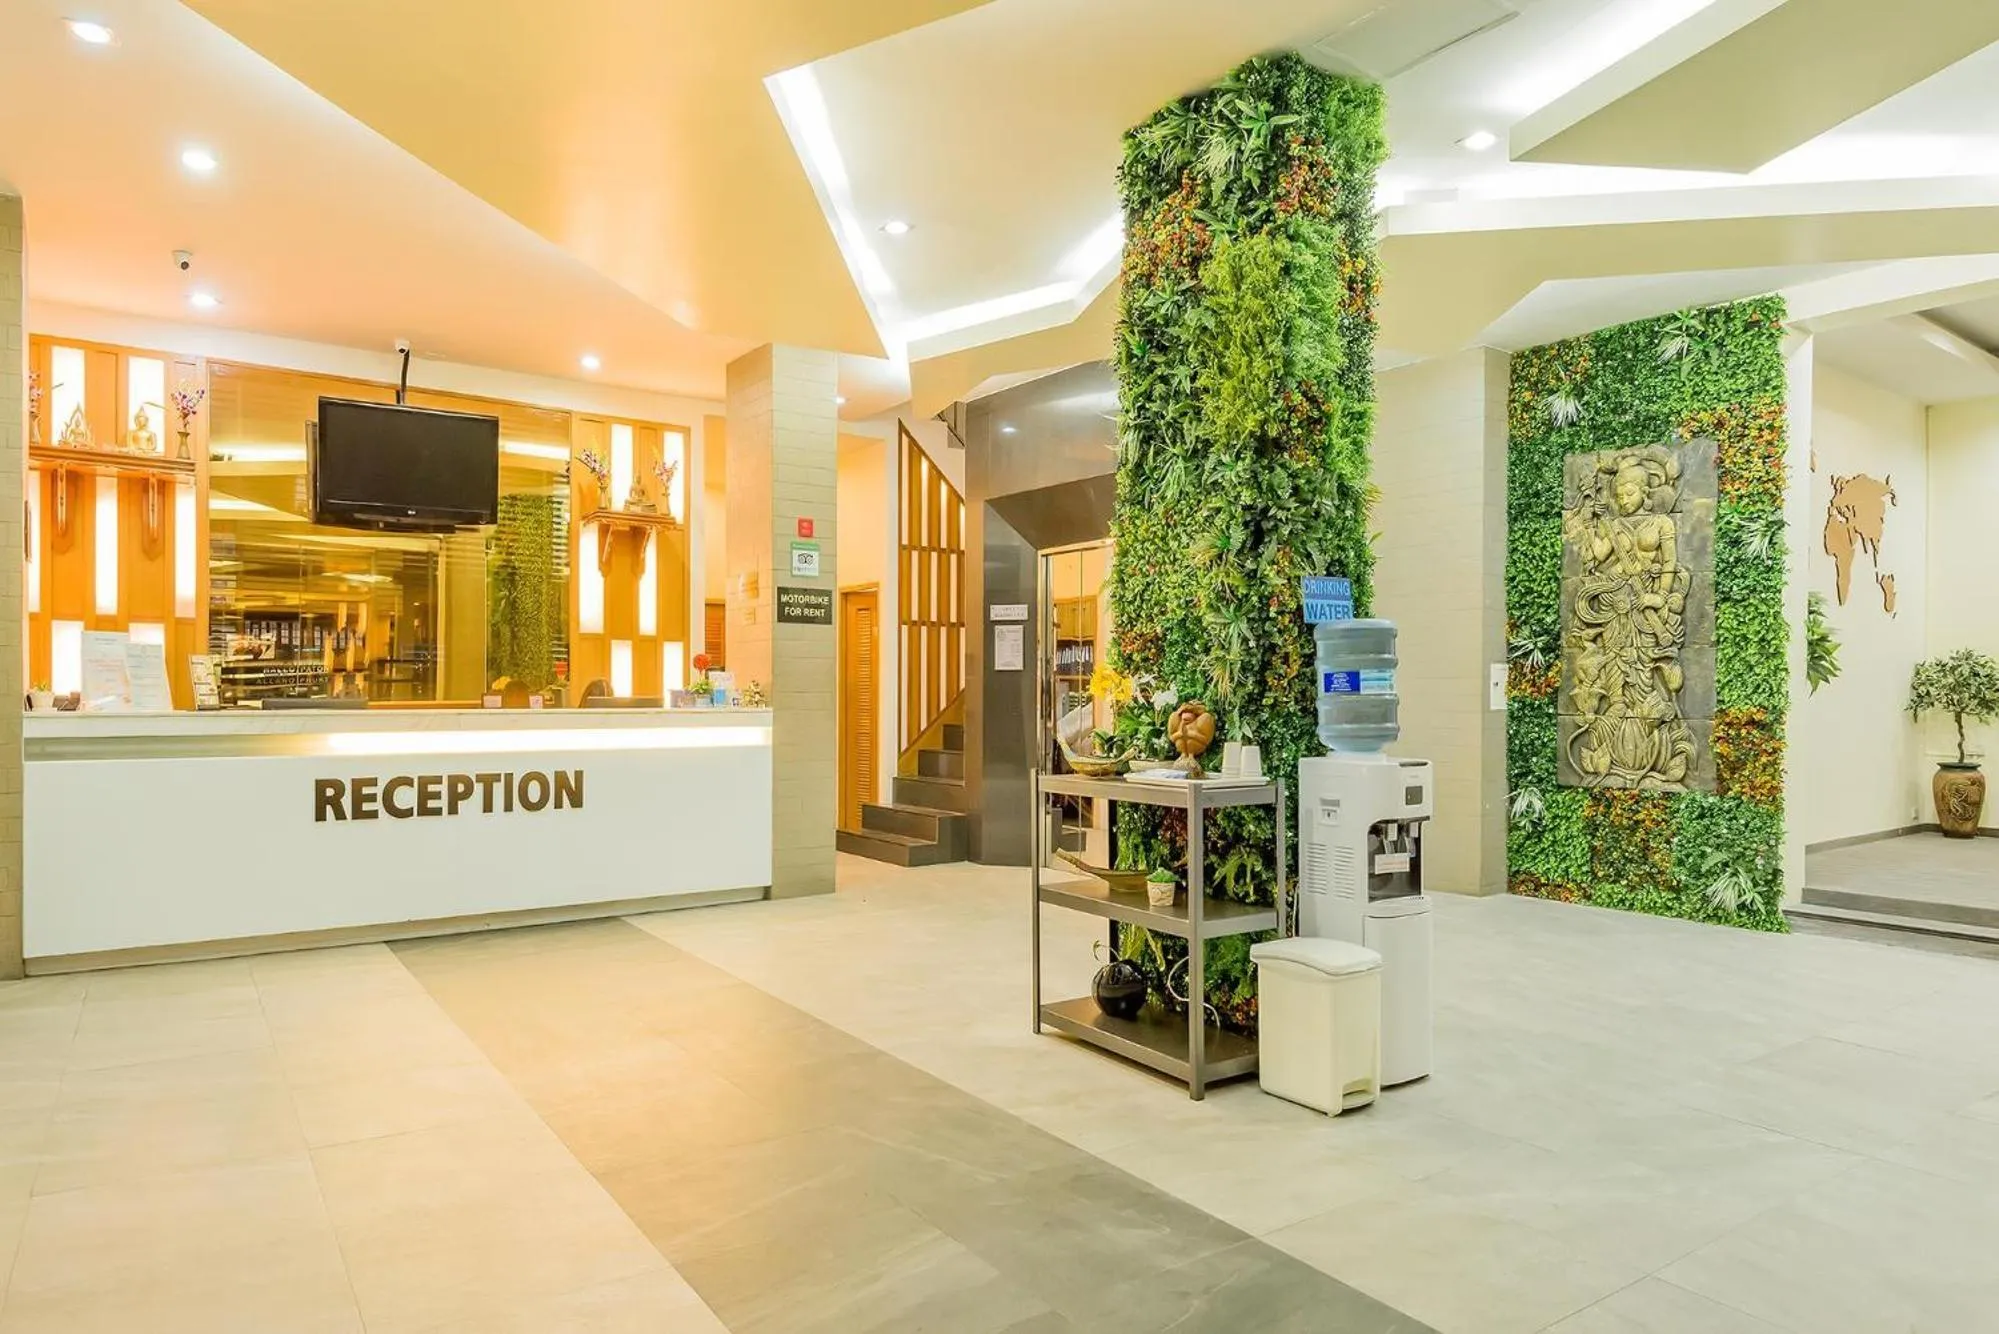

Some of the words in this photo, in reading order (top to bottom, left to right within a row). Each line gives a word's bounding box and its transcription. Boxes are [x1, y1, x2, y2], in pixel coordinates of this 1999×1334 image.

[1304, 580, 1350, 596] DRINKING
[780, 594, 829, 605] MOTORBIKE
[785, 607, 802, 616] FOR
[803, 608, 826, 617] RENT
[1306, 603, 1351, 620] WATER
[315, 770, 584, 822] RECEPTION
